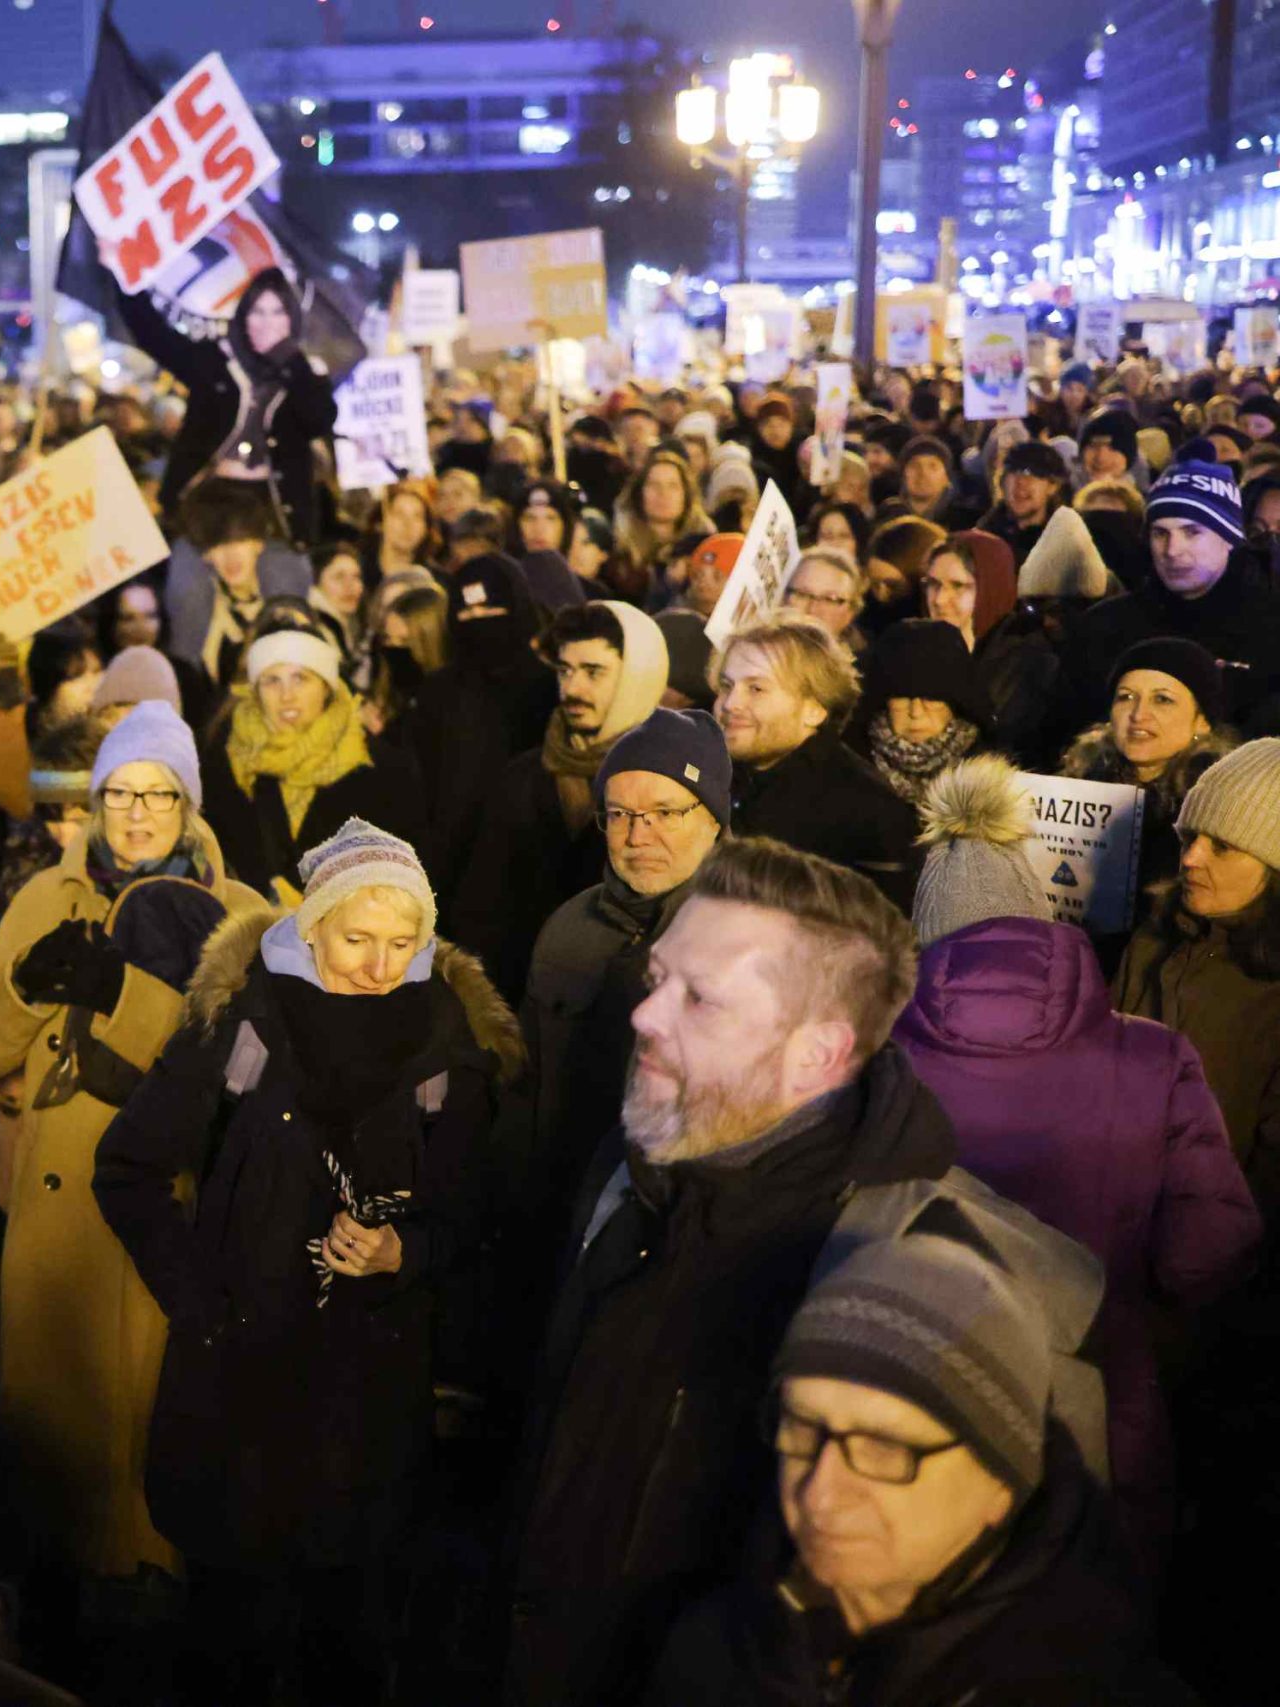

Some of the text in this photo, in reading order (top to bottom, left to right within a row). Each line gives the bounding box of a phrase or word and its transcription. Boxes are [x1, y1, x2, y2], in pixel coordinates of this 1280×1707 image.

[95, 71, 226, 219] FUC
[119, 125, 256, 287] NZS
[16, 487, 96, 556] ESSEN
